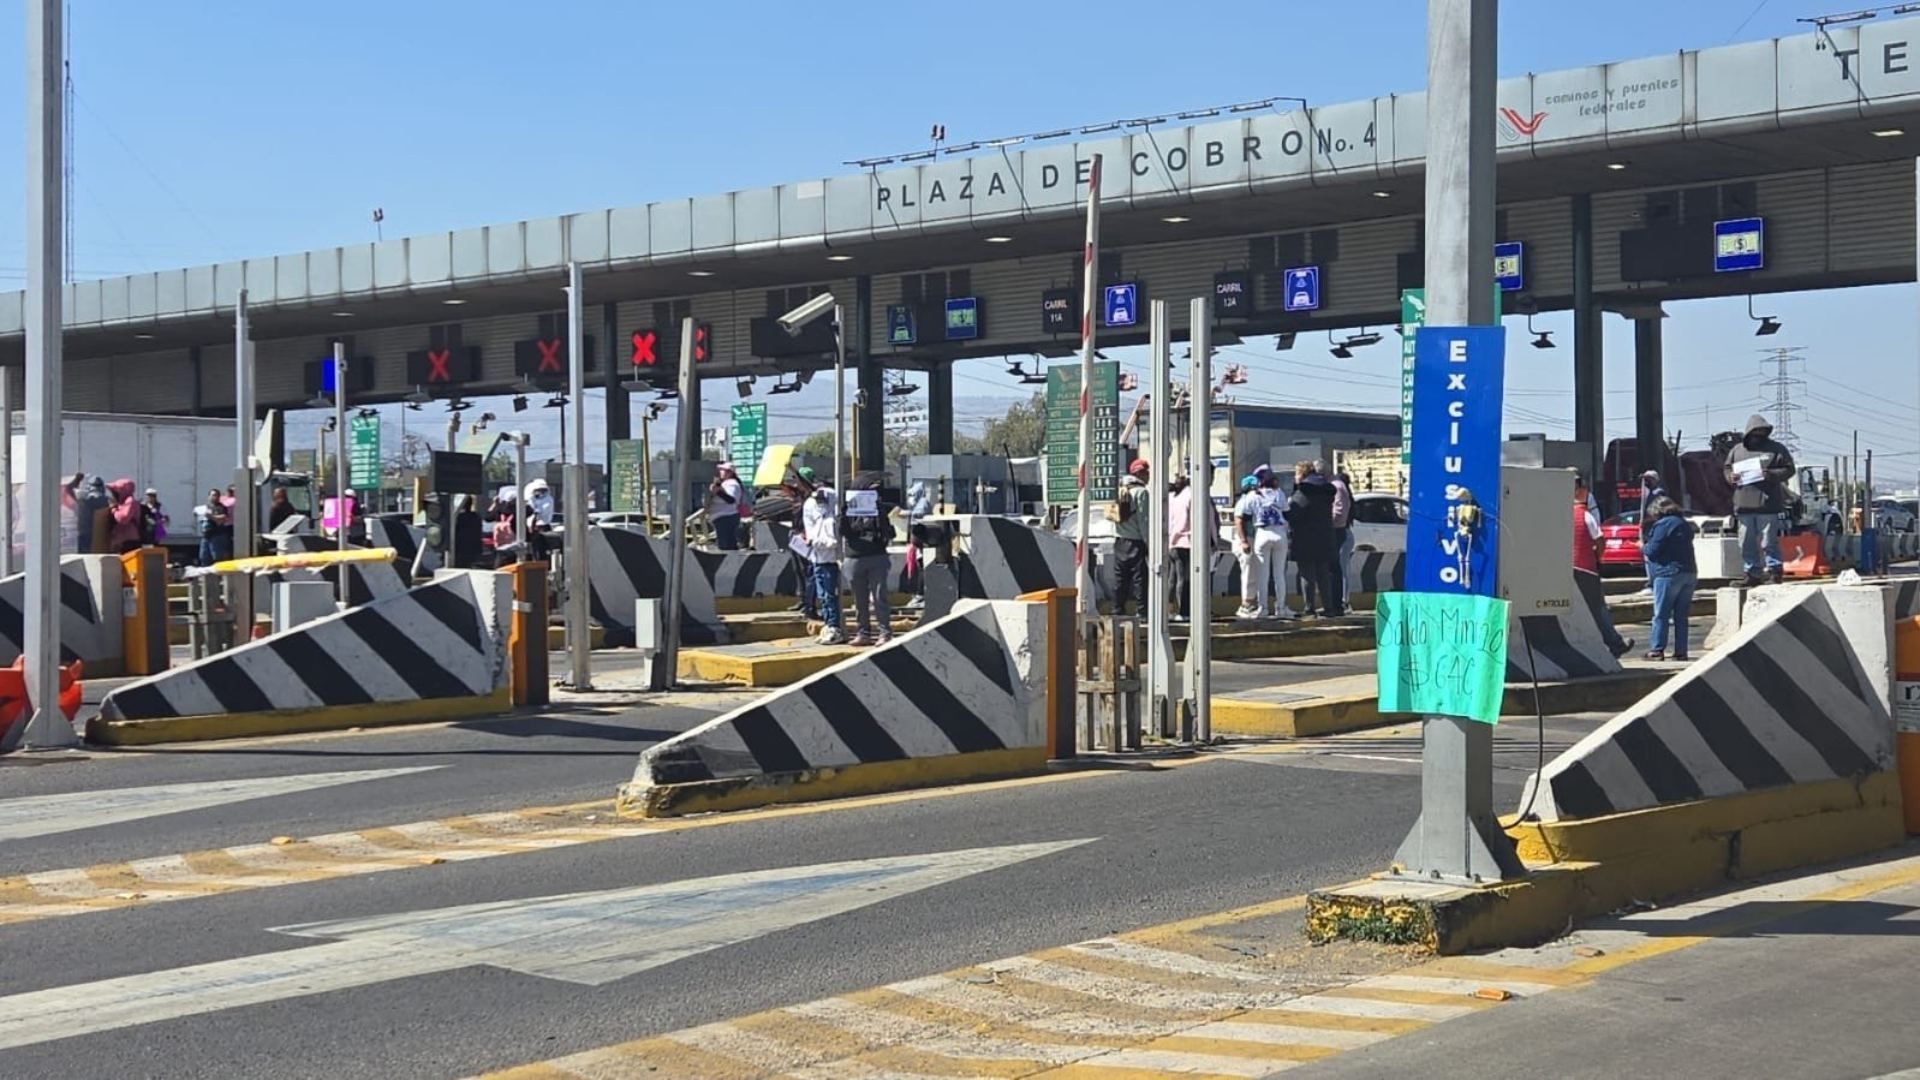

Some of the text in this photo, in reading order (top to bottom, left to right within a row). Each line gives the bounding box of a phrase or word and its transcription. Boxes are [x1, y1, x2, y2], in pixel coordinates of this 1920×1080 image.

[1545, 90, 1598, 105] caminos
[1622, 79, 1679, 97] puentes
[1579, 99, 1647, 116] federales
[877, 121, 1377, 211] PLAZA DE COBRO No. 4
[1216, 282, 1243, 294] CARRIL
[1044, 299, 1068, 311] CARRIL
[1440, 340, 1468, 583] Exclusivo
[1441, 608, 1475, 645] Min
